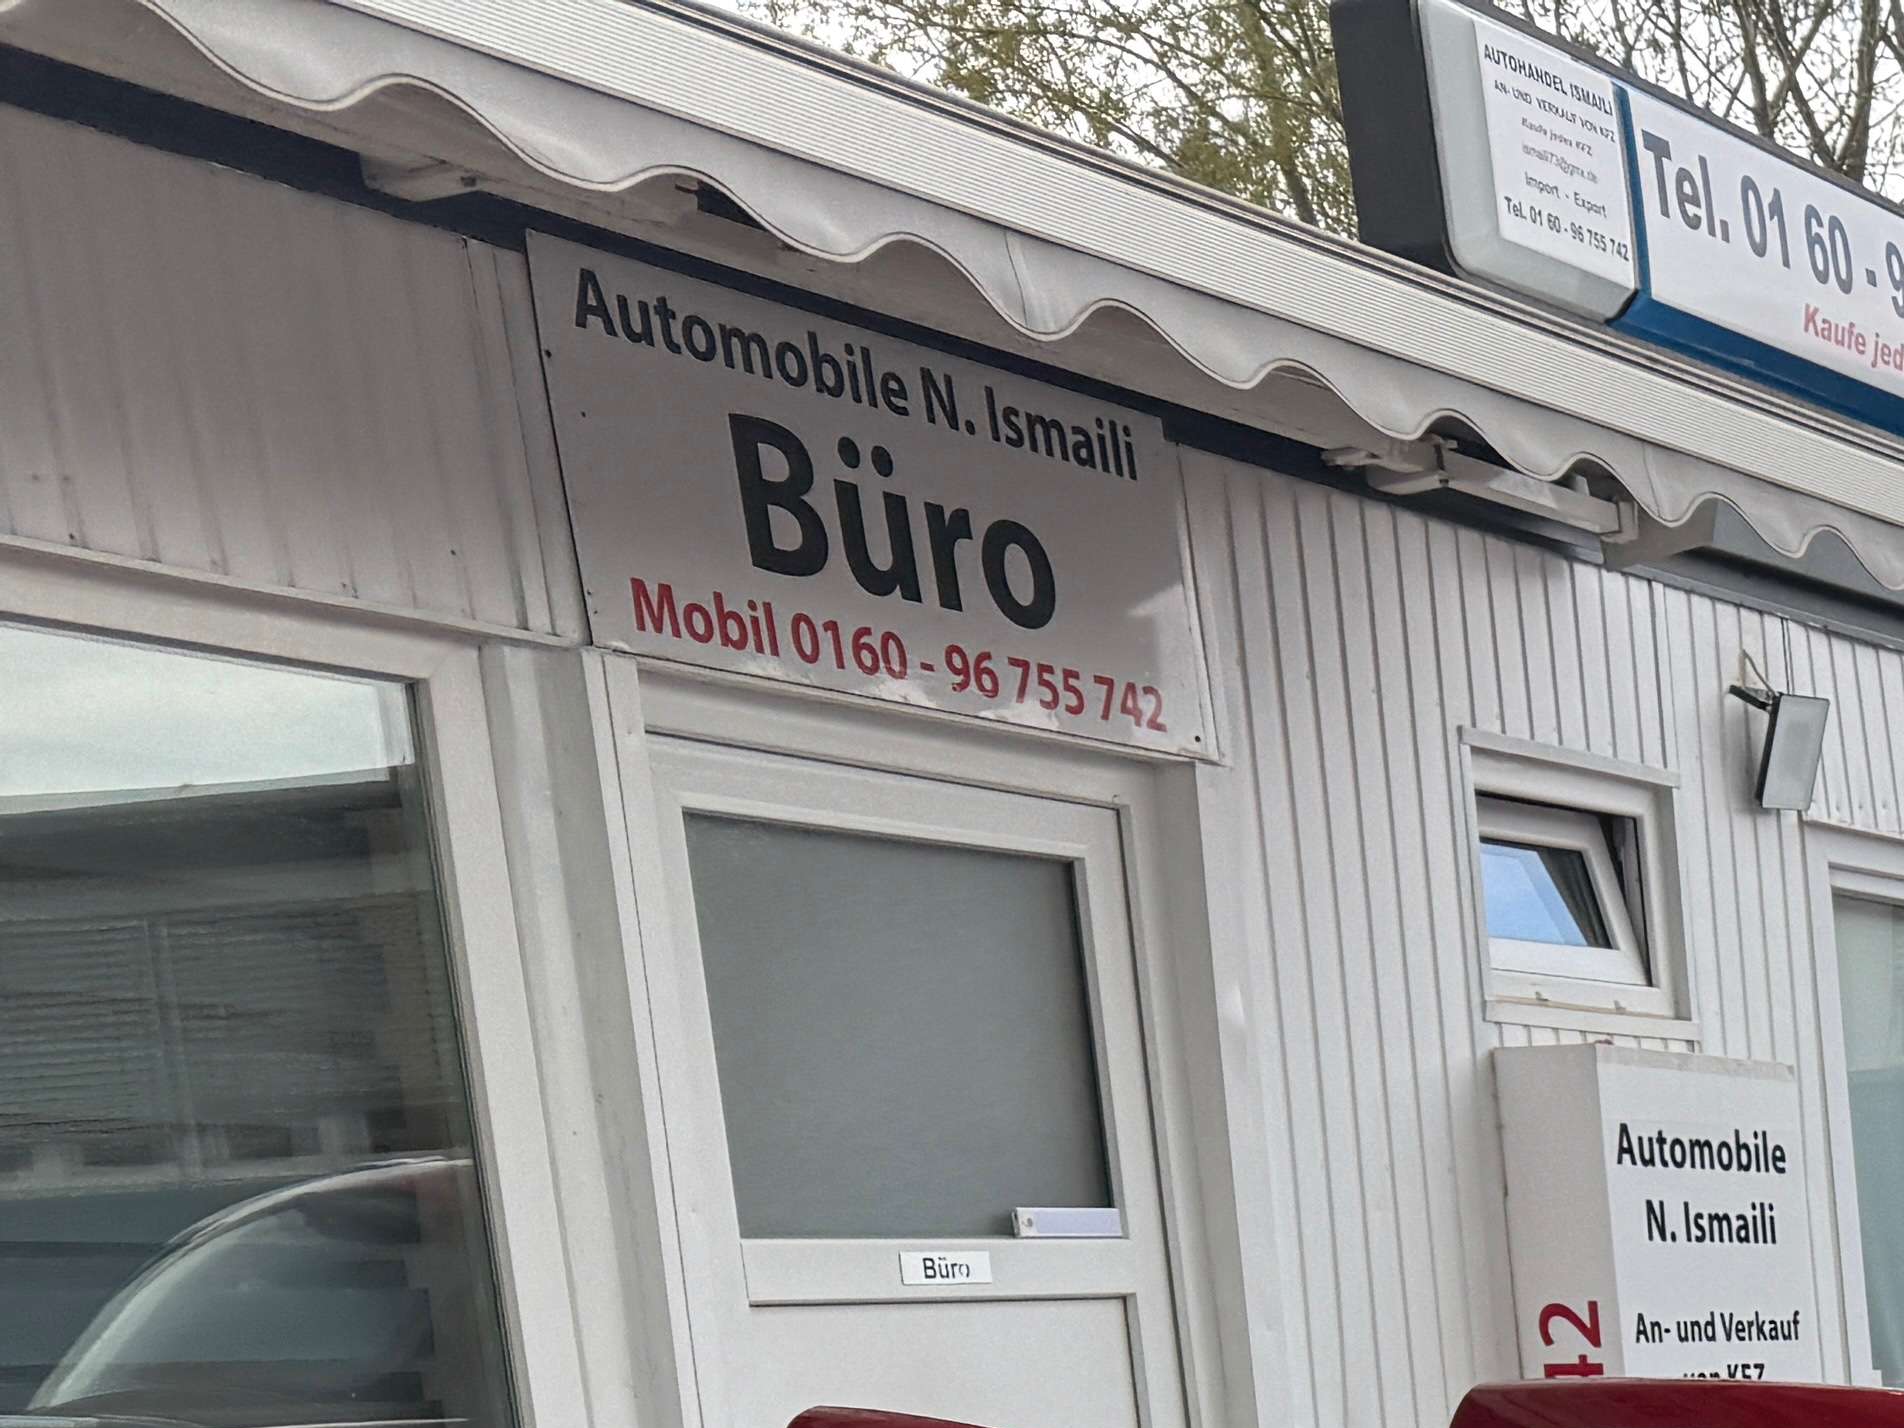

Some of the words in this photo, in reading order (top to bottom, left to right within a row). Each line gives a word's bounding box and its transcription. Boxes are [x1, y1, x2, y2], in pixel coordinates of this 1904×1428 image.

[1484, 43, 1567, 95] AUTOHANDEL
[1569, 82, 1613, 117] ISMAILI
[1524, 171, 1560, 197] Import
[1574, 191, 1608, 218] Export
[1641, 128, 1731, 244] Tel.
[1740, 174, 1791, 270] 01
[1804, 203, 1853, 295] 60
[1865, 267, 1878, 288] -
[1529, 206, 1543, 226] 01
[1547, 213, 1561, 234] 60
[1570, 222, 1585, 243] 96
[1587, 229, 1607, 253] 755
[1609, 238, 1630, 261] 742
[1803, 303, 1866, 356] Kaufe
[575, 267, 910, 417] Automobile
[920, 366, 977, 437] N.
[984, 384, 1138, 481] Ismaili
[728, 411, 1058, 630] Büro
[630, 576, 780, 658] Mobil
[791, 611, 908, 681] 0160
[945, 643, 1000, 699] 96
[1007, 655, 1086, 716] 755
[1093, 674, 1168, 732] 742
[1617, 1122, 1787, 1175] Automobile
[1646, 1199, 1677, 1243] N.
[1683, 1200, 1777, 1245] Ismaili
[922, 1256, 970, 1280] Büro
[1635, 1312, 1671, 1344] An-
[1676, 1311, 1717, 1344] und
[1719, 1310, 1801, 1342] Verkauf
